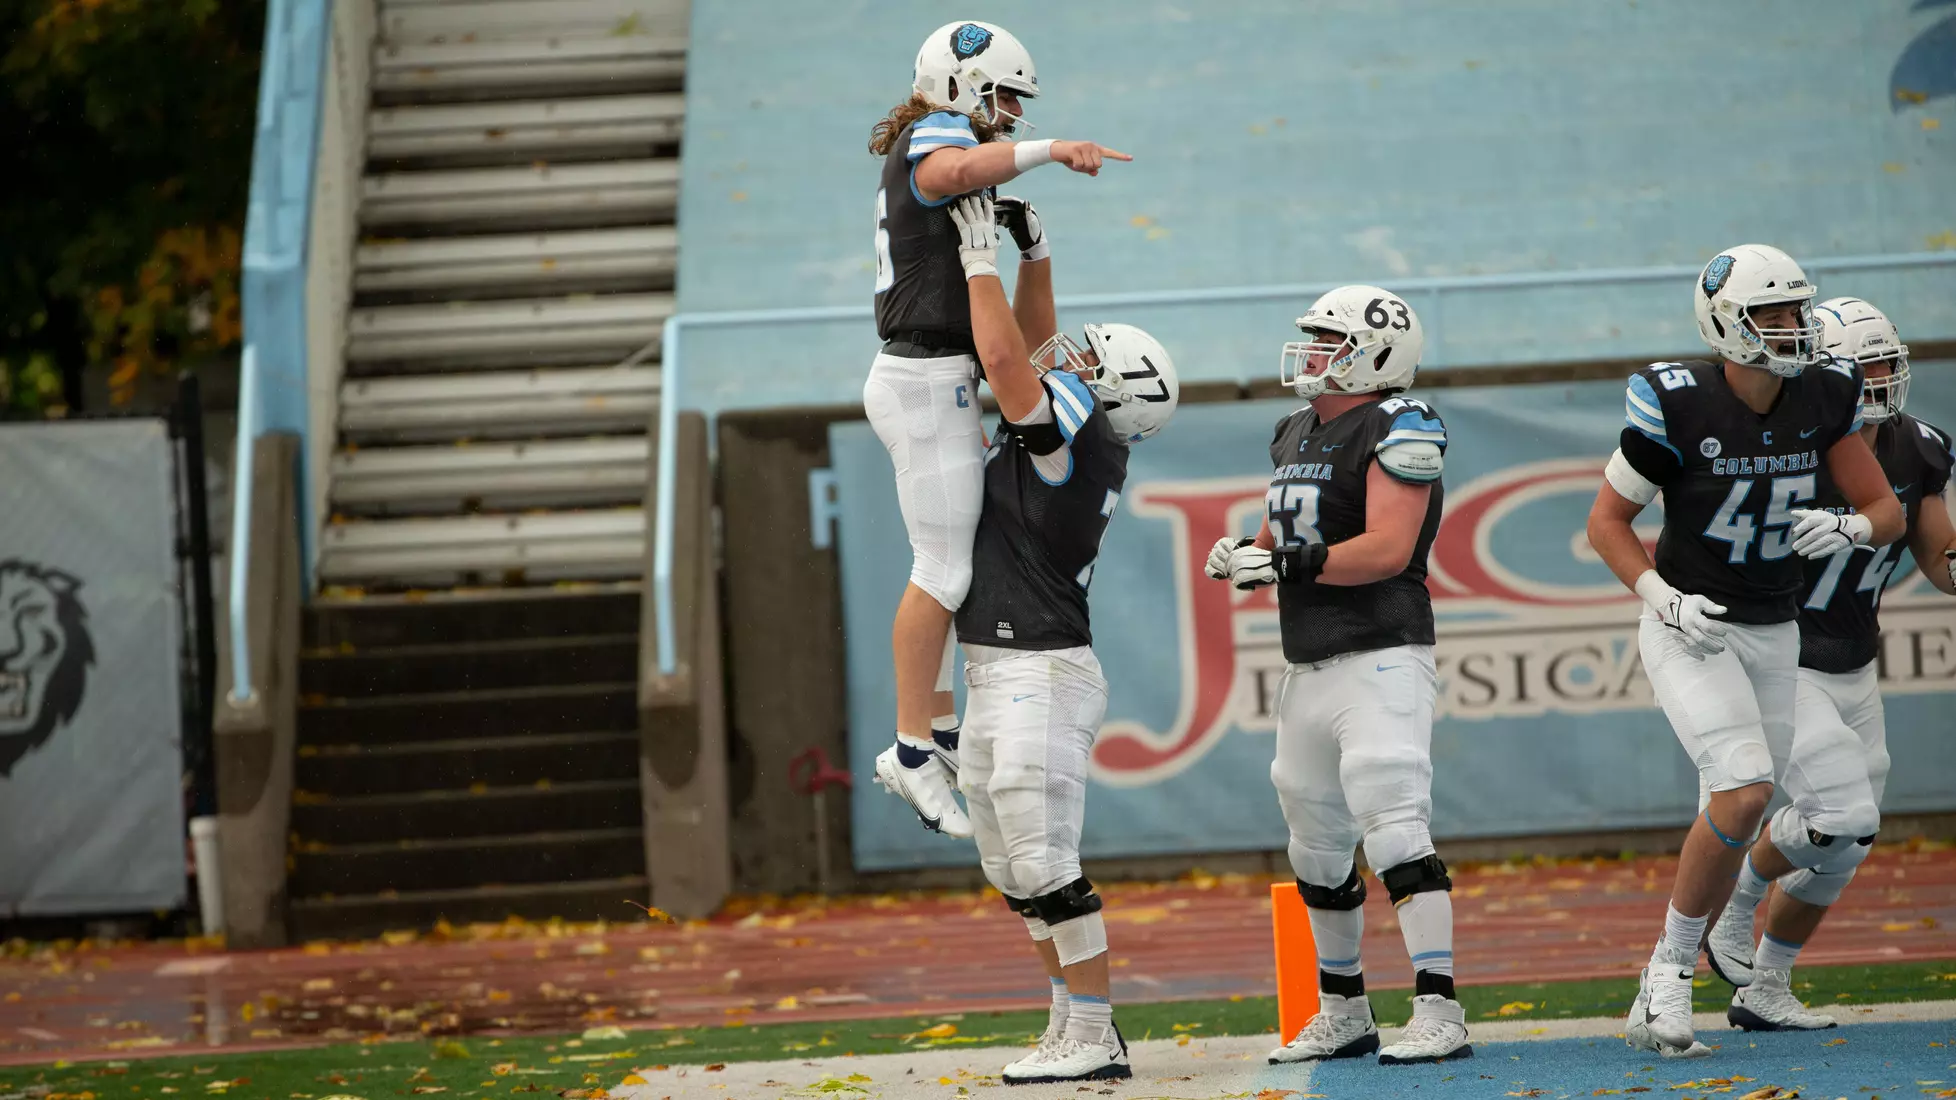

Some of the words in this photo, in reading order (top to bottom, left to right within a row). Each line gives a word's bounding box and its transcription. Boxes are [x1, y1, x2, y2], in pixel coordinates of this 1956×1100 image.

[1787, 279, 1808, 290] LIONS
[1364, 298, 1411, 332] 63
[955, 384, 970, 409] C
[1762, 431, 1773, 445] C
[1712, 449, 1818, 475] COLUMBIA
[1263, 484, 1326, 548] 63
[1703, 472, 1816, 564] 45
[997, 621, 1012, 629] 2XL
